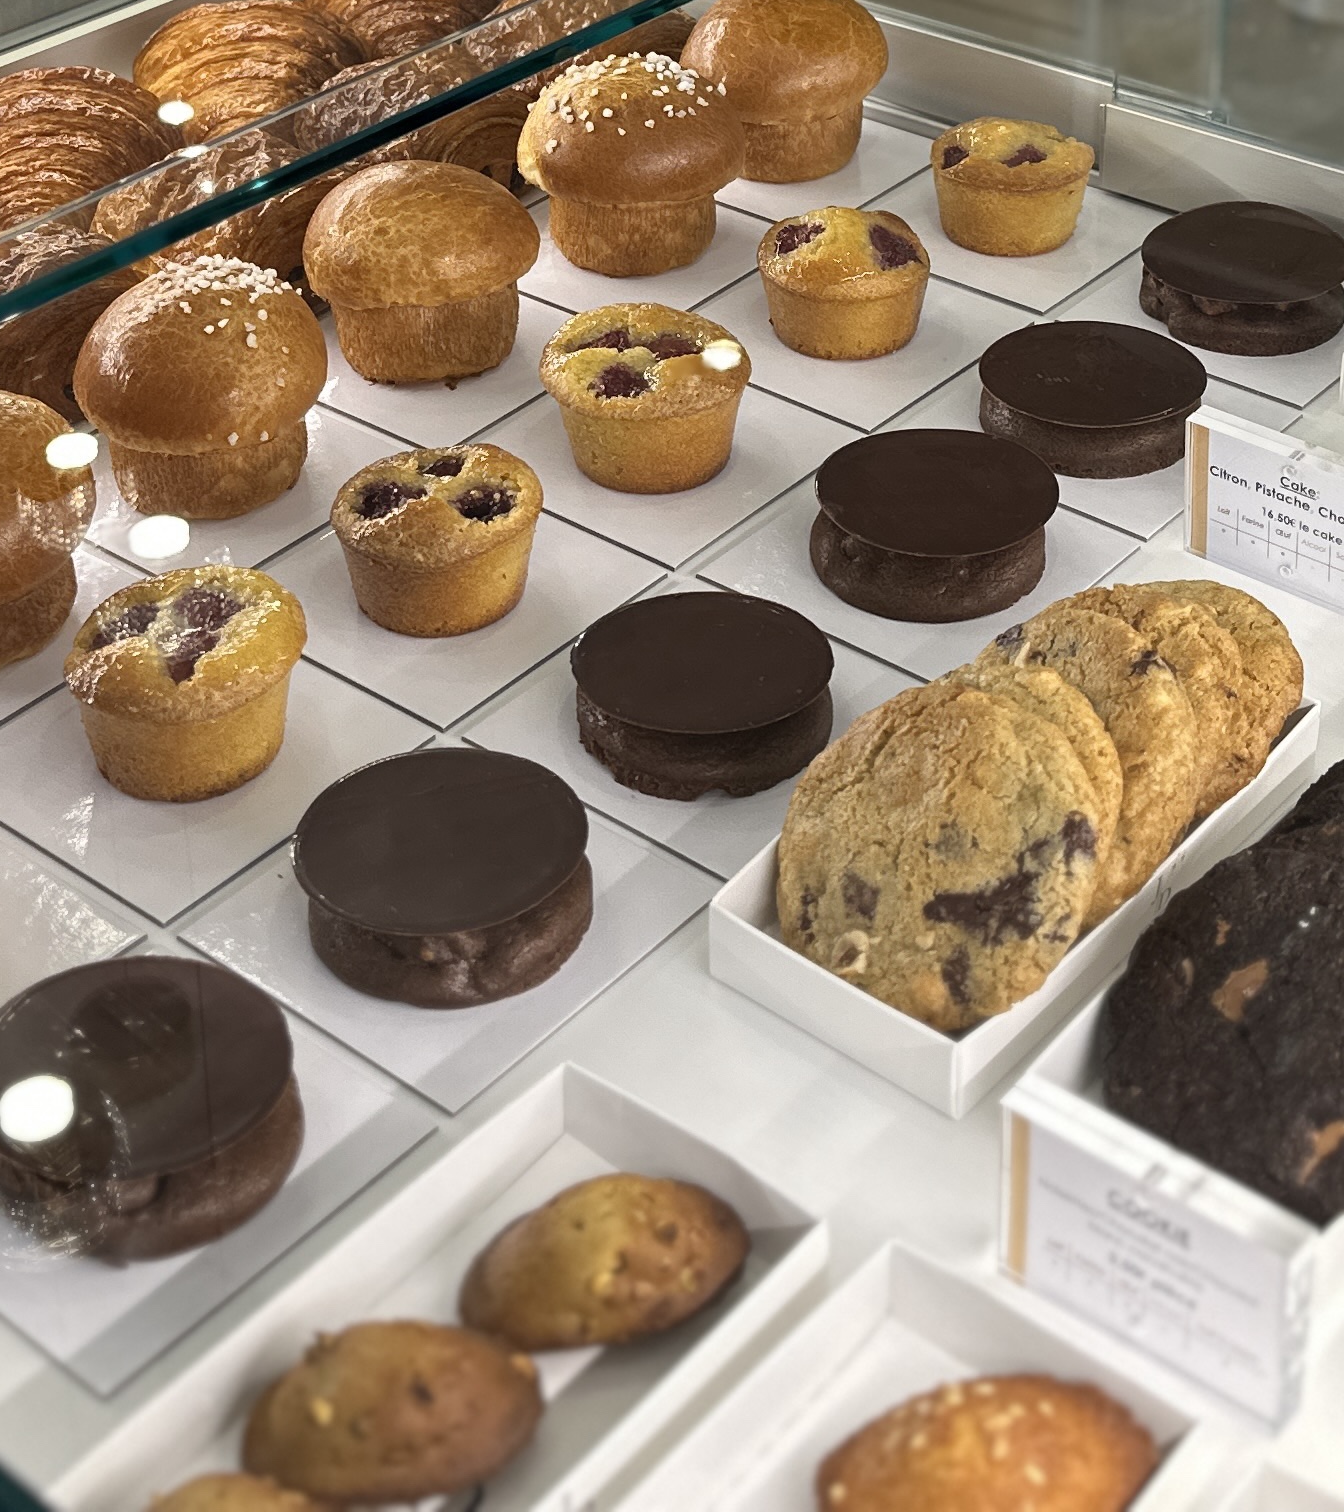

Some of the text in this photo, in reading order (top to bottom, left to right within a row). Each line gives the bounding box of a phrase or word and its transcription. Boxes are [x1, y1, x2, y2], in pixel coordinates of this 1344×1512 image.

[1209, 465, 1252, 490] Citron,
[1255, 481, 1314, 514] Pistache,
[1299, 520, 1310, 533] le
[1312, 528, 1343, 546] cake
